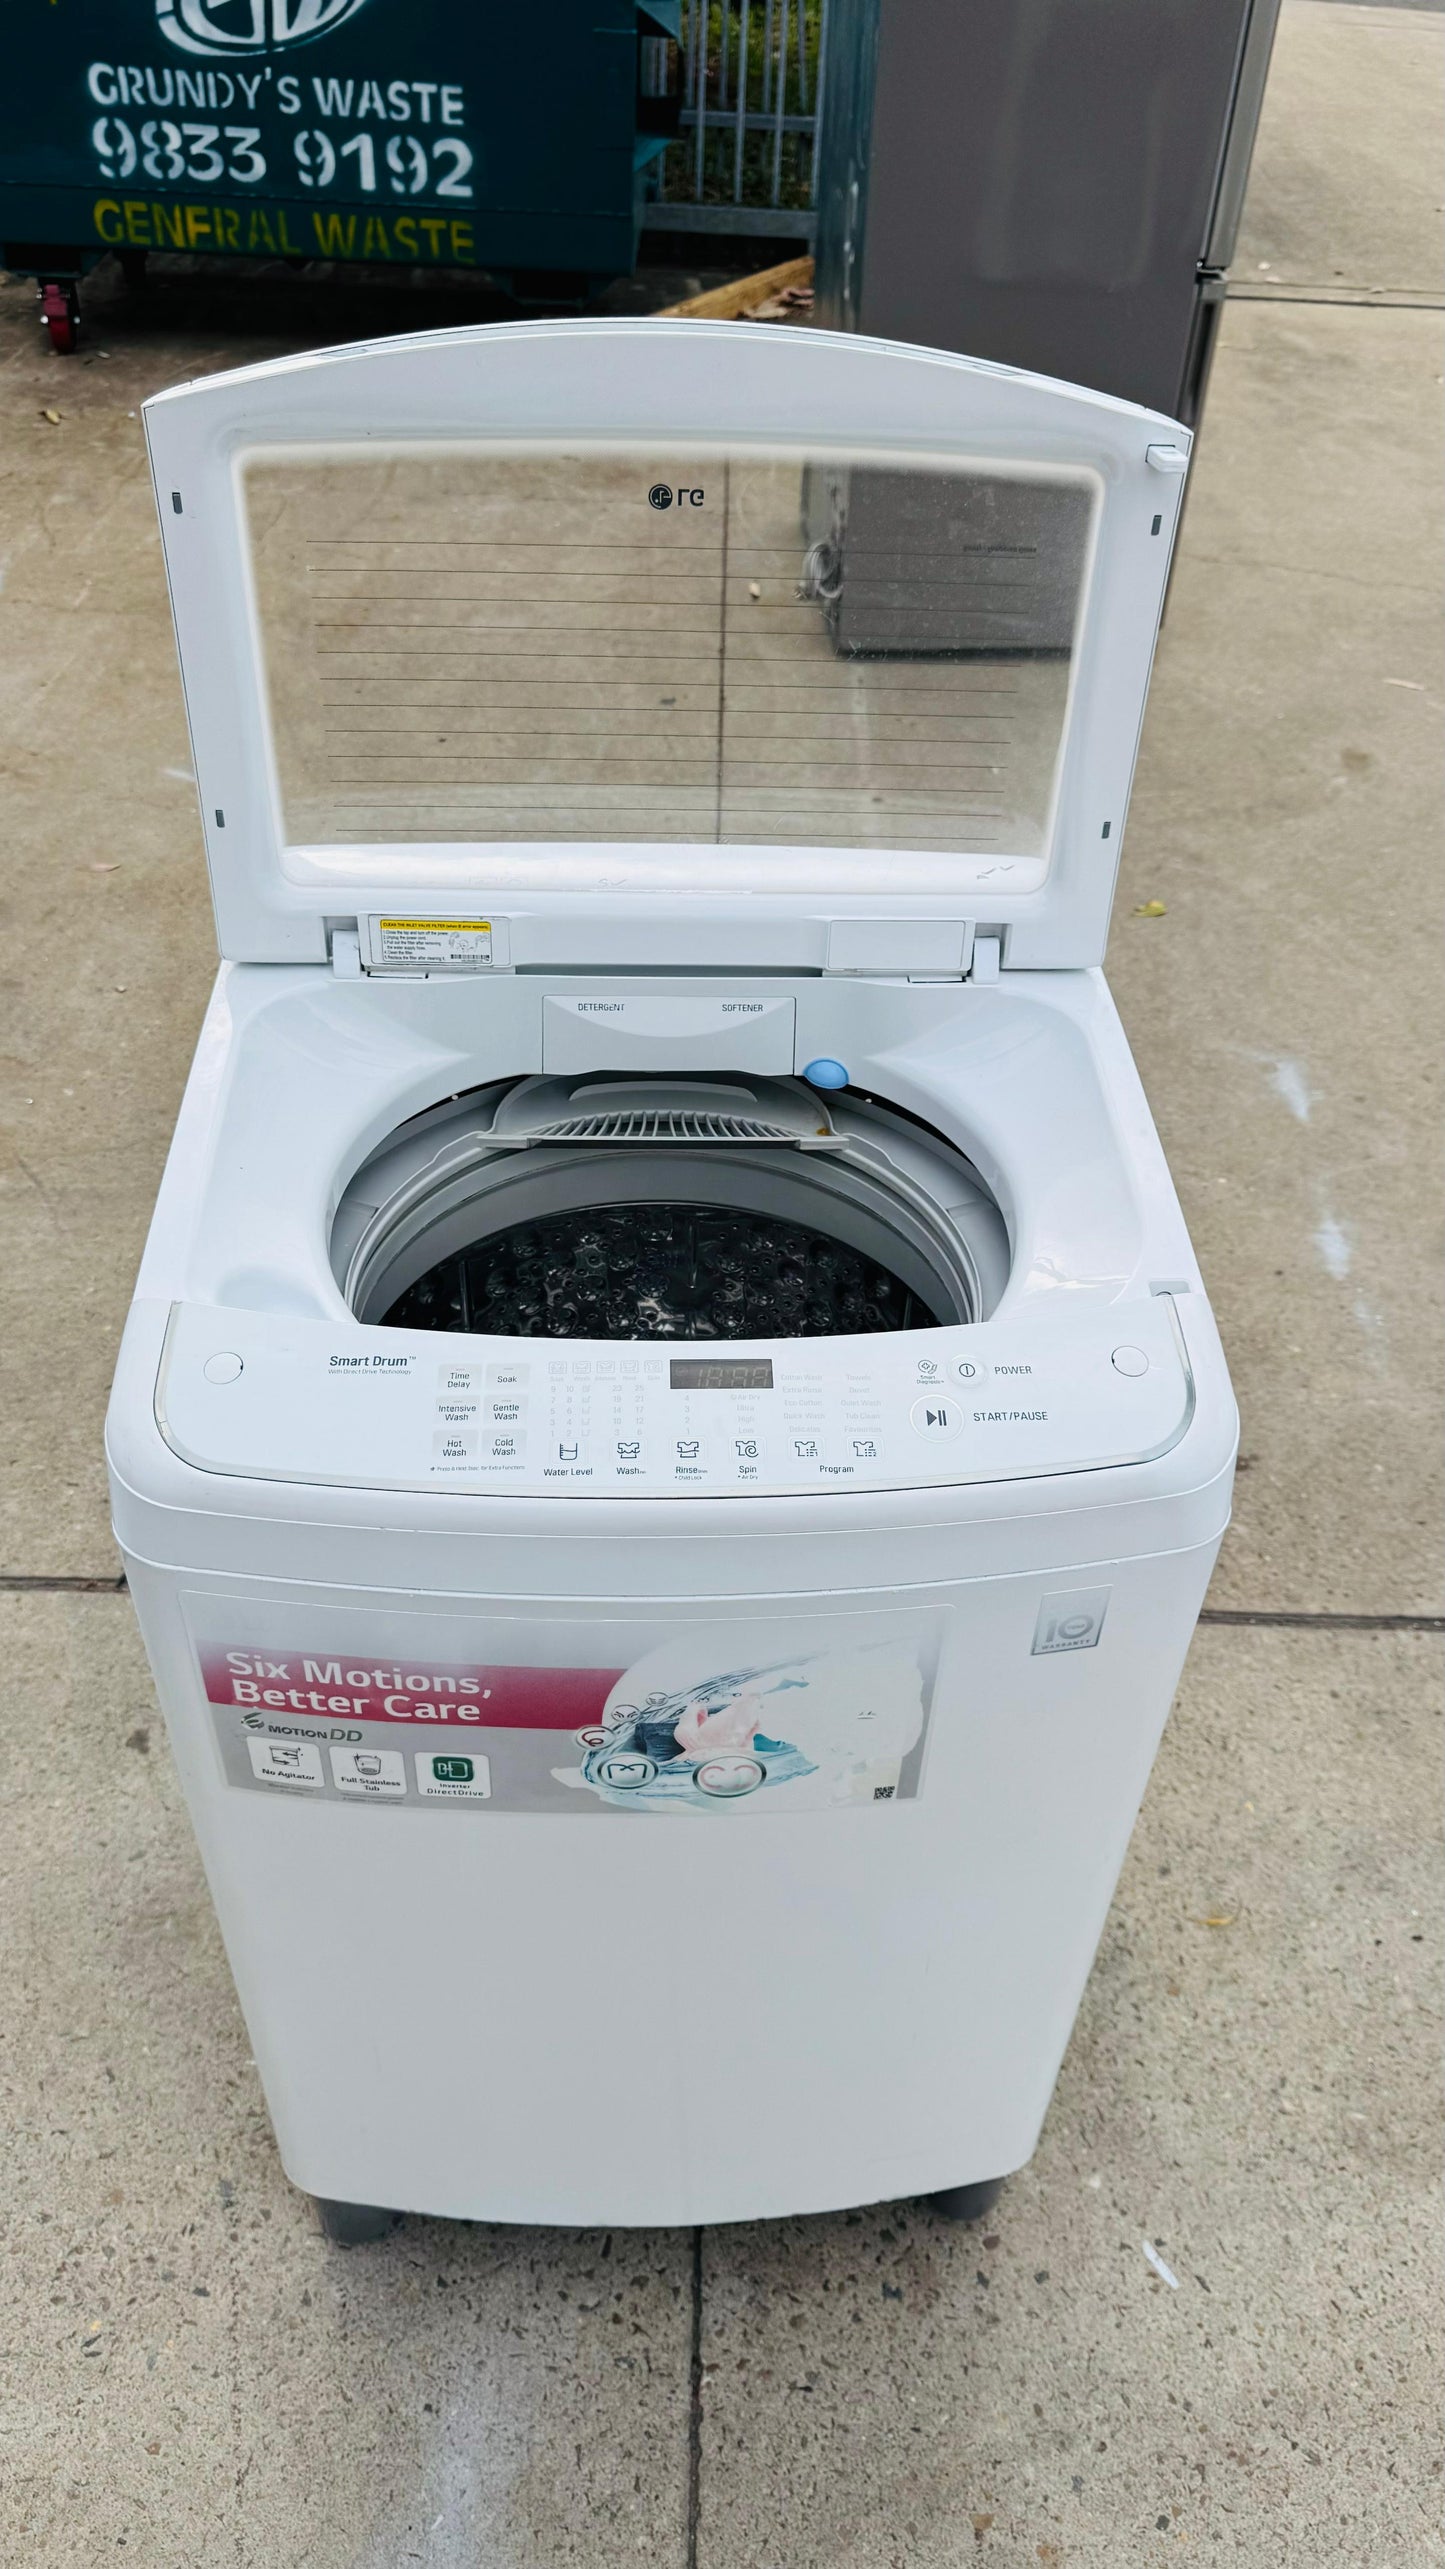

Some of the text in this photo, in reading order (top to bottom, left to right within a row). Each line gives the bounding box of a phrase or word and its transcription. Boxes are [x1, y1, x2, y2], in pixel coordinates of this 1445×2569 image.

[87, 63, 466, 126] GRUNDY'S WASTE
[92, 116, 474, 198] 9833 9192
[312, 211, 476, 264] WASTE
[722, 1004, 764, 1013] SOFTENER
[329, 1355, 370, 1366] Smart
[994, 1366, 1033, 1375] POWER
[450, 1372, 470, 1380] Time
[497, 1375, 517, 1384] Soak
[447, 1380, 471, 1389] Delay
[438, 1404, 477, 1413] Intensive
[493, 1404, 520, 1412] Gentle
[445, 1413, 469, 1421] Wash
[494, 1412, 518, 1421] Wash
[973, 1411, 1049, 1422] START/PAUSE
[447, 1439, 462, 1448] Hot
[495, 1439, 514, 1447] Cold
[443, 1449, 467, 1457] Wash
[492, 1448, 516, 1456] Wash
[544, 1467, 593, 1477] Water Level
[616, 1467, 640, 1475] Wash
[675, 1466, 698, 1474] Rinse
[739, 1465, 757, 1475] Spin
[820, 1465, 854, 1475] Program
[226, 1652, 493, 1700] Six Motions,
[231, 1678, 481, 1721] Better Care
[262, 1768, 315, 1780] No Agitator
[341, 1776, 401, 1787] Full Stainless
